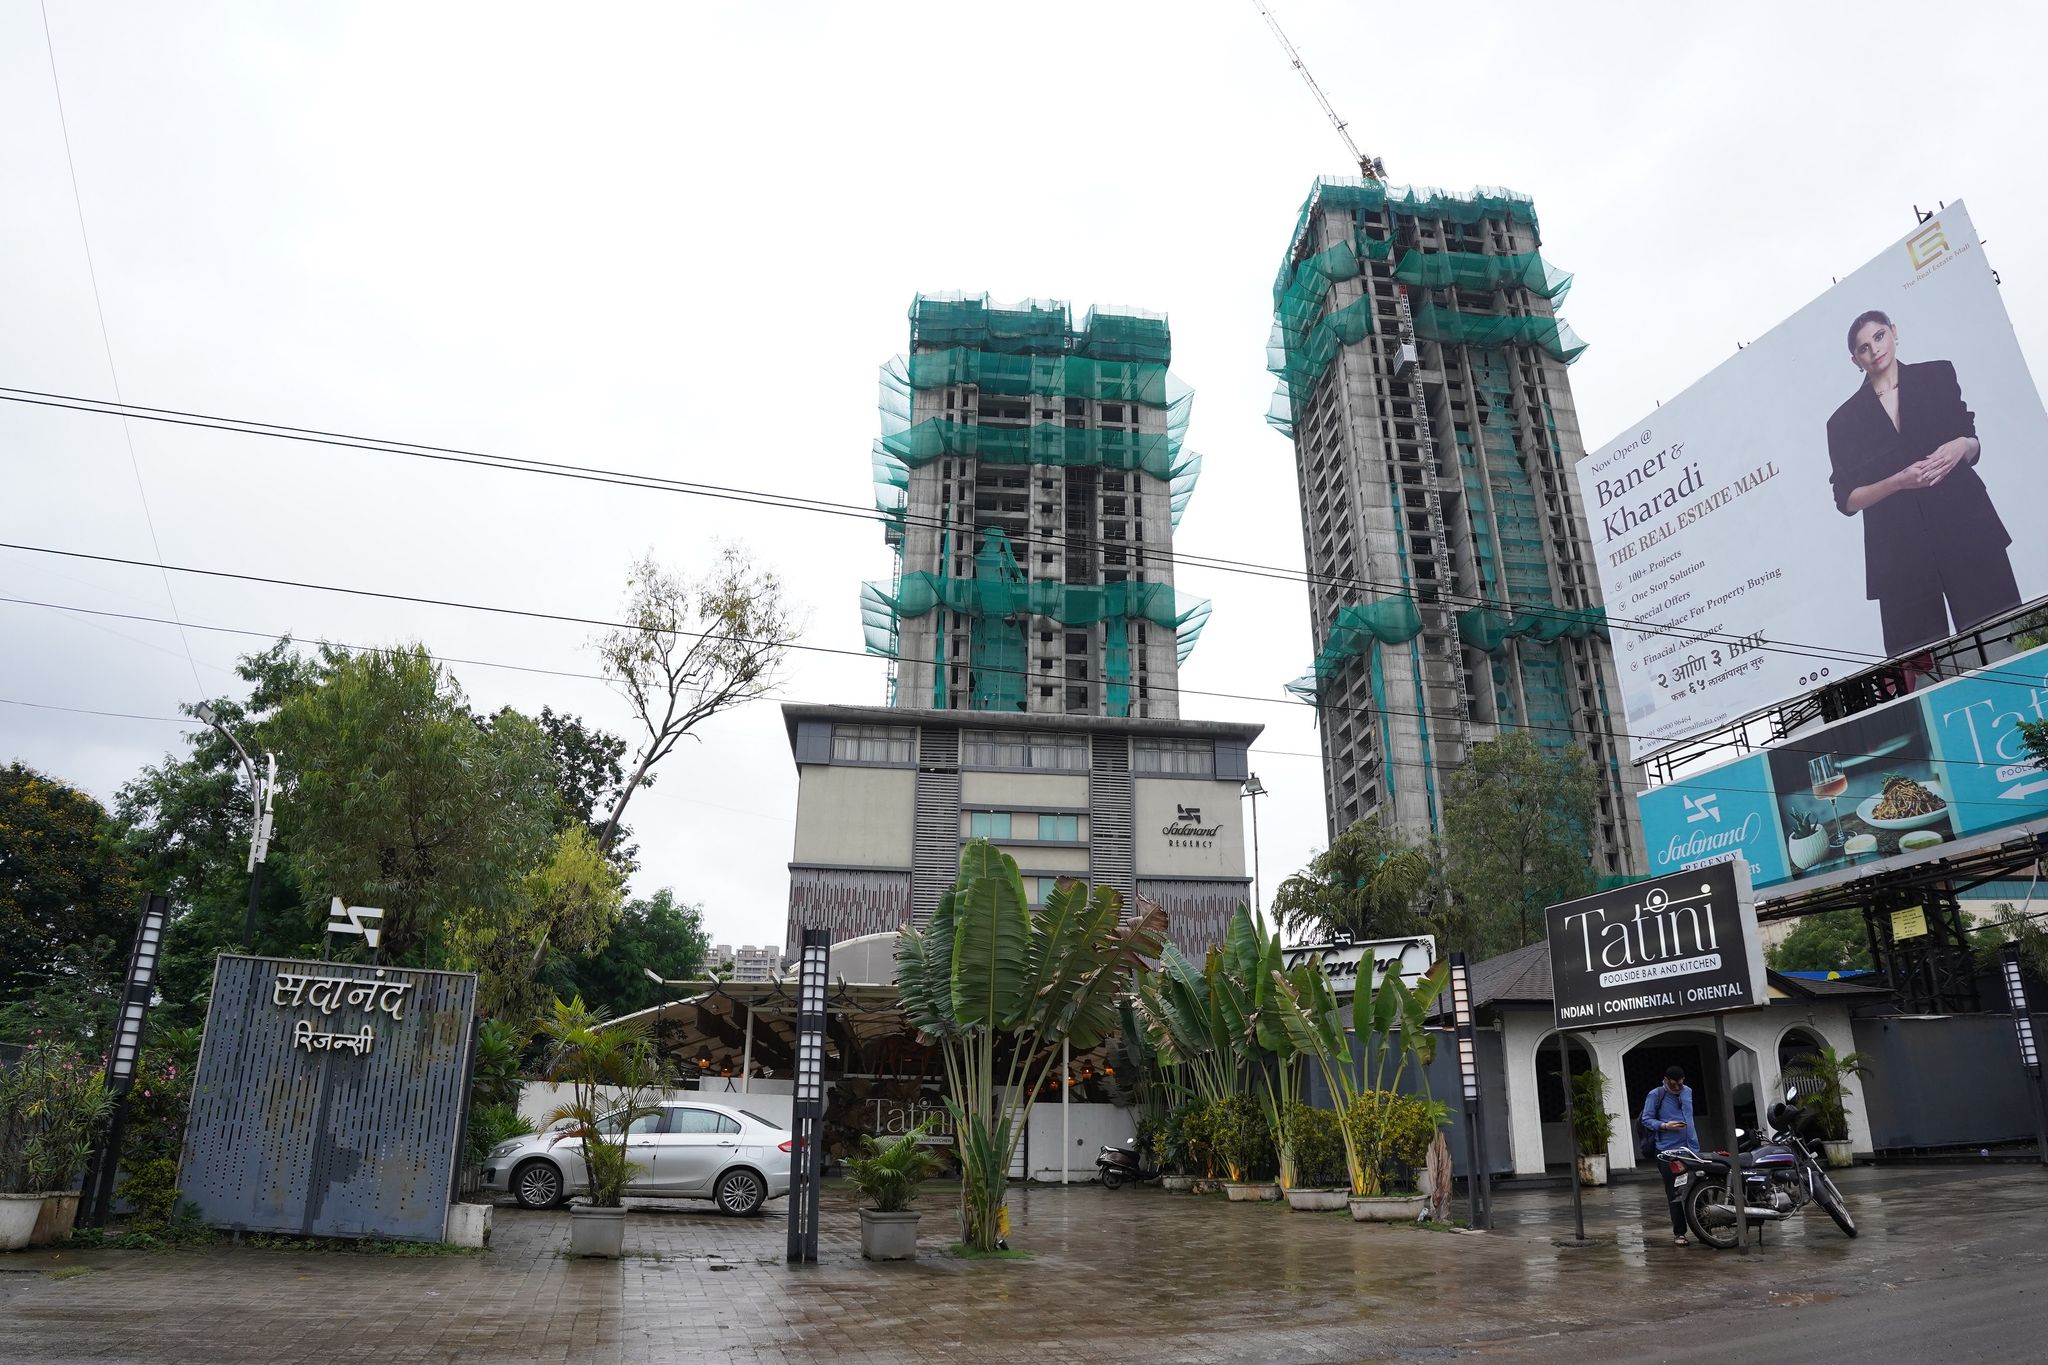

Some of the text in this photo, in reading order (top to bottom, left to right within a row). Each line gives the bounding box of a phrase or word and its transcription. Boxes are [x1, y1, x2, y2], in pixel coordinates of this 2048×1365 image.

[1903, 242, 1971, 290] The Real Estate Mall
[1591, 456, 1612, 476] Now
[1613, 441, 1639, 460] Open
[1594, 449, 1667, 509] Baner
[1602, 462, 1704, 544] Kharadi
[1609, 461, 1780, 568] THE REAL ESTATE MALL
[1628, 550, 1682, 584] 100+ Projects
[1631, 559, 1706, 604] One Stop Solution
[1634, 591, 1691, 624] Special Offers
[1638, 567, 1783, 643] Marketplace For Property Buying
[1643, 622, 1725, 666] Finacial Assistance
[1657, 629, 1768, 689] २ आणि ३ BHK
[1162, 821, 1224, 837] Sadanand
[1168, 839, 1212, 848] REGENCY
[1658, 812, 1761, 865] Sadanand
[1564, 883, 1720, 973] Tatini
[1603, 956, 1717, 985] POOLSIDE BAR AND KITCHEN
[273, 969, 413, 1021] सदानंद
[1560, 981, 1744, 1020] INDIAN CONTINENTAL ORIENTAL
[293, 1019, 375, 1056] रिजन्सी
